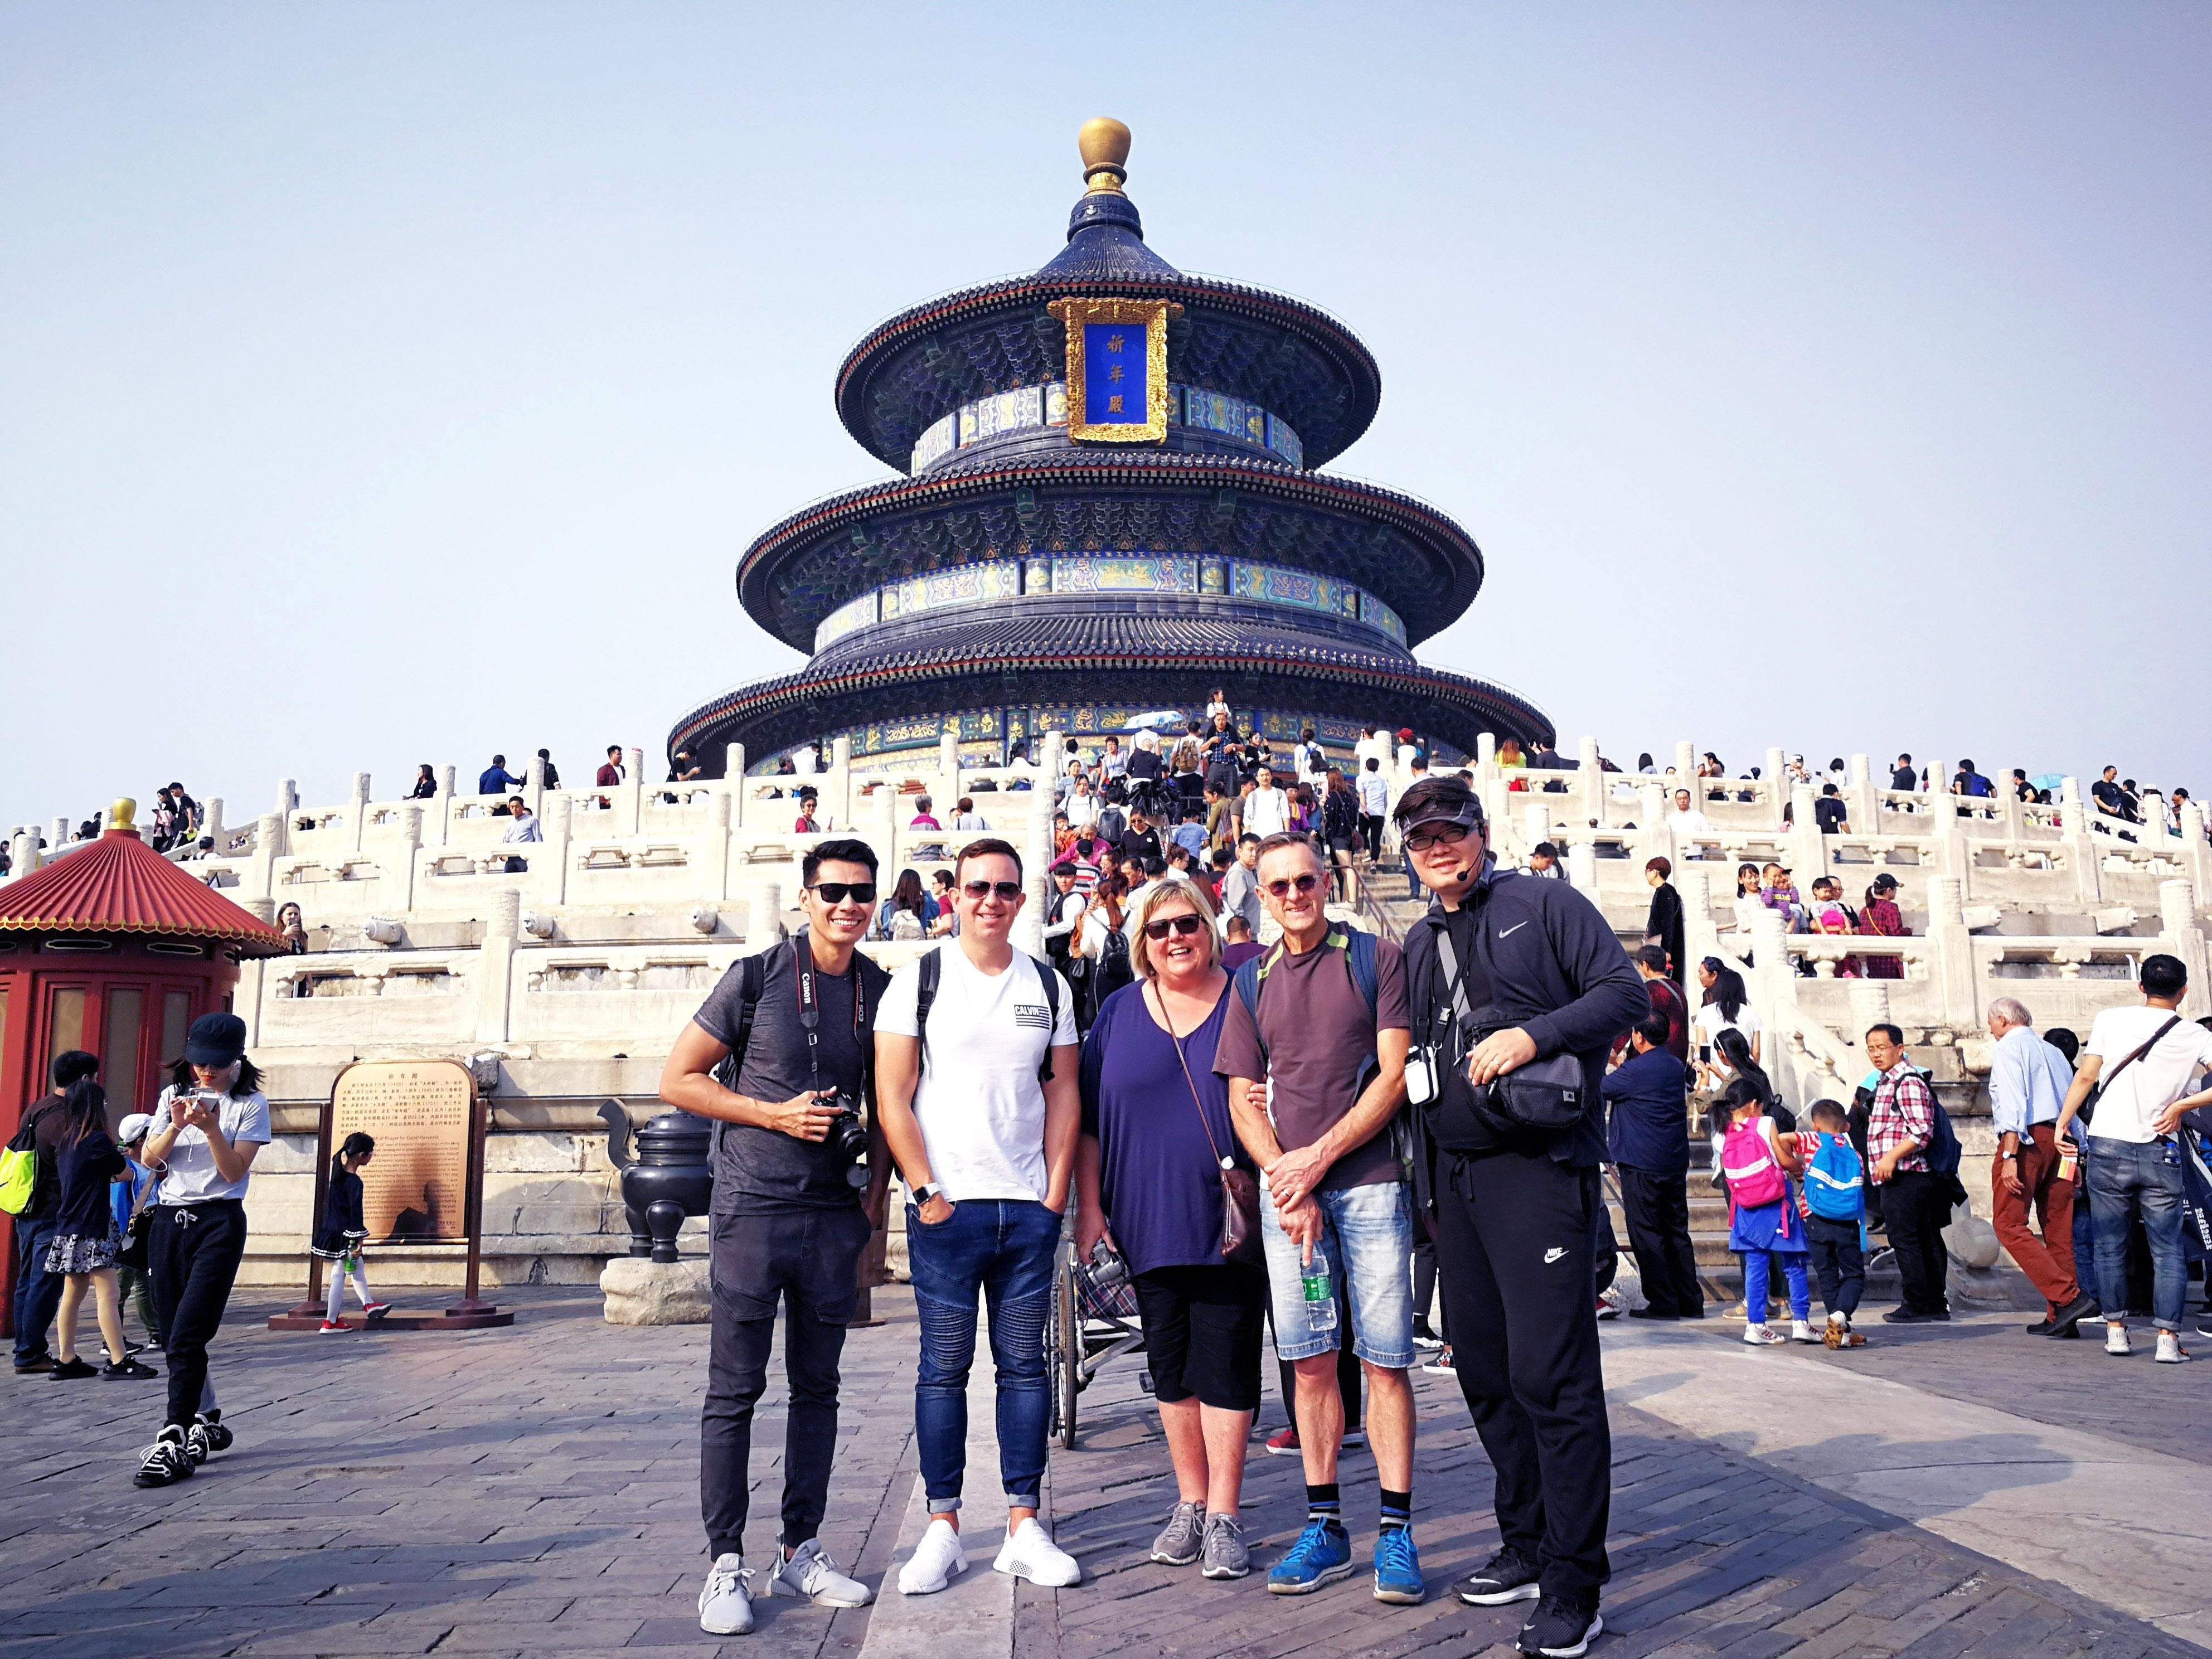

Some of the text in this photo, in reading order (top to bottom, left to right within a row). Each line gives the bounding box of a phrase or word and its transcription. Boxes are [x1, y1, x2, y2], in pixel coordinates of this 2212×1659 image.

[1107, 334, 1126, 414] 祈年殿
[802, 973, 811, 1003] Canon
[1015, 1006, 1040, 1016] CALVIN
[1547, 1247, 1563, 1258] NIKE
